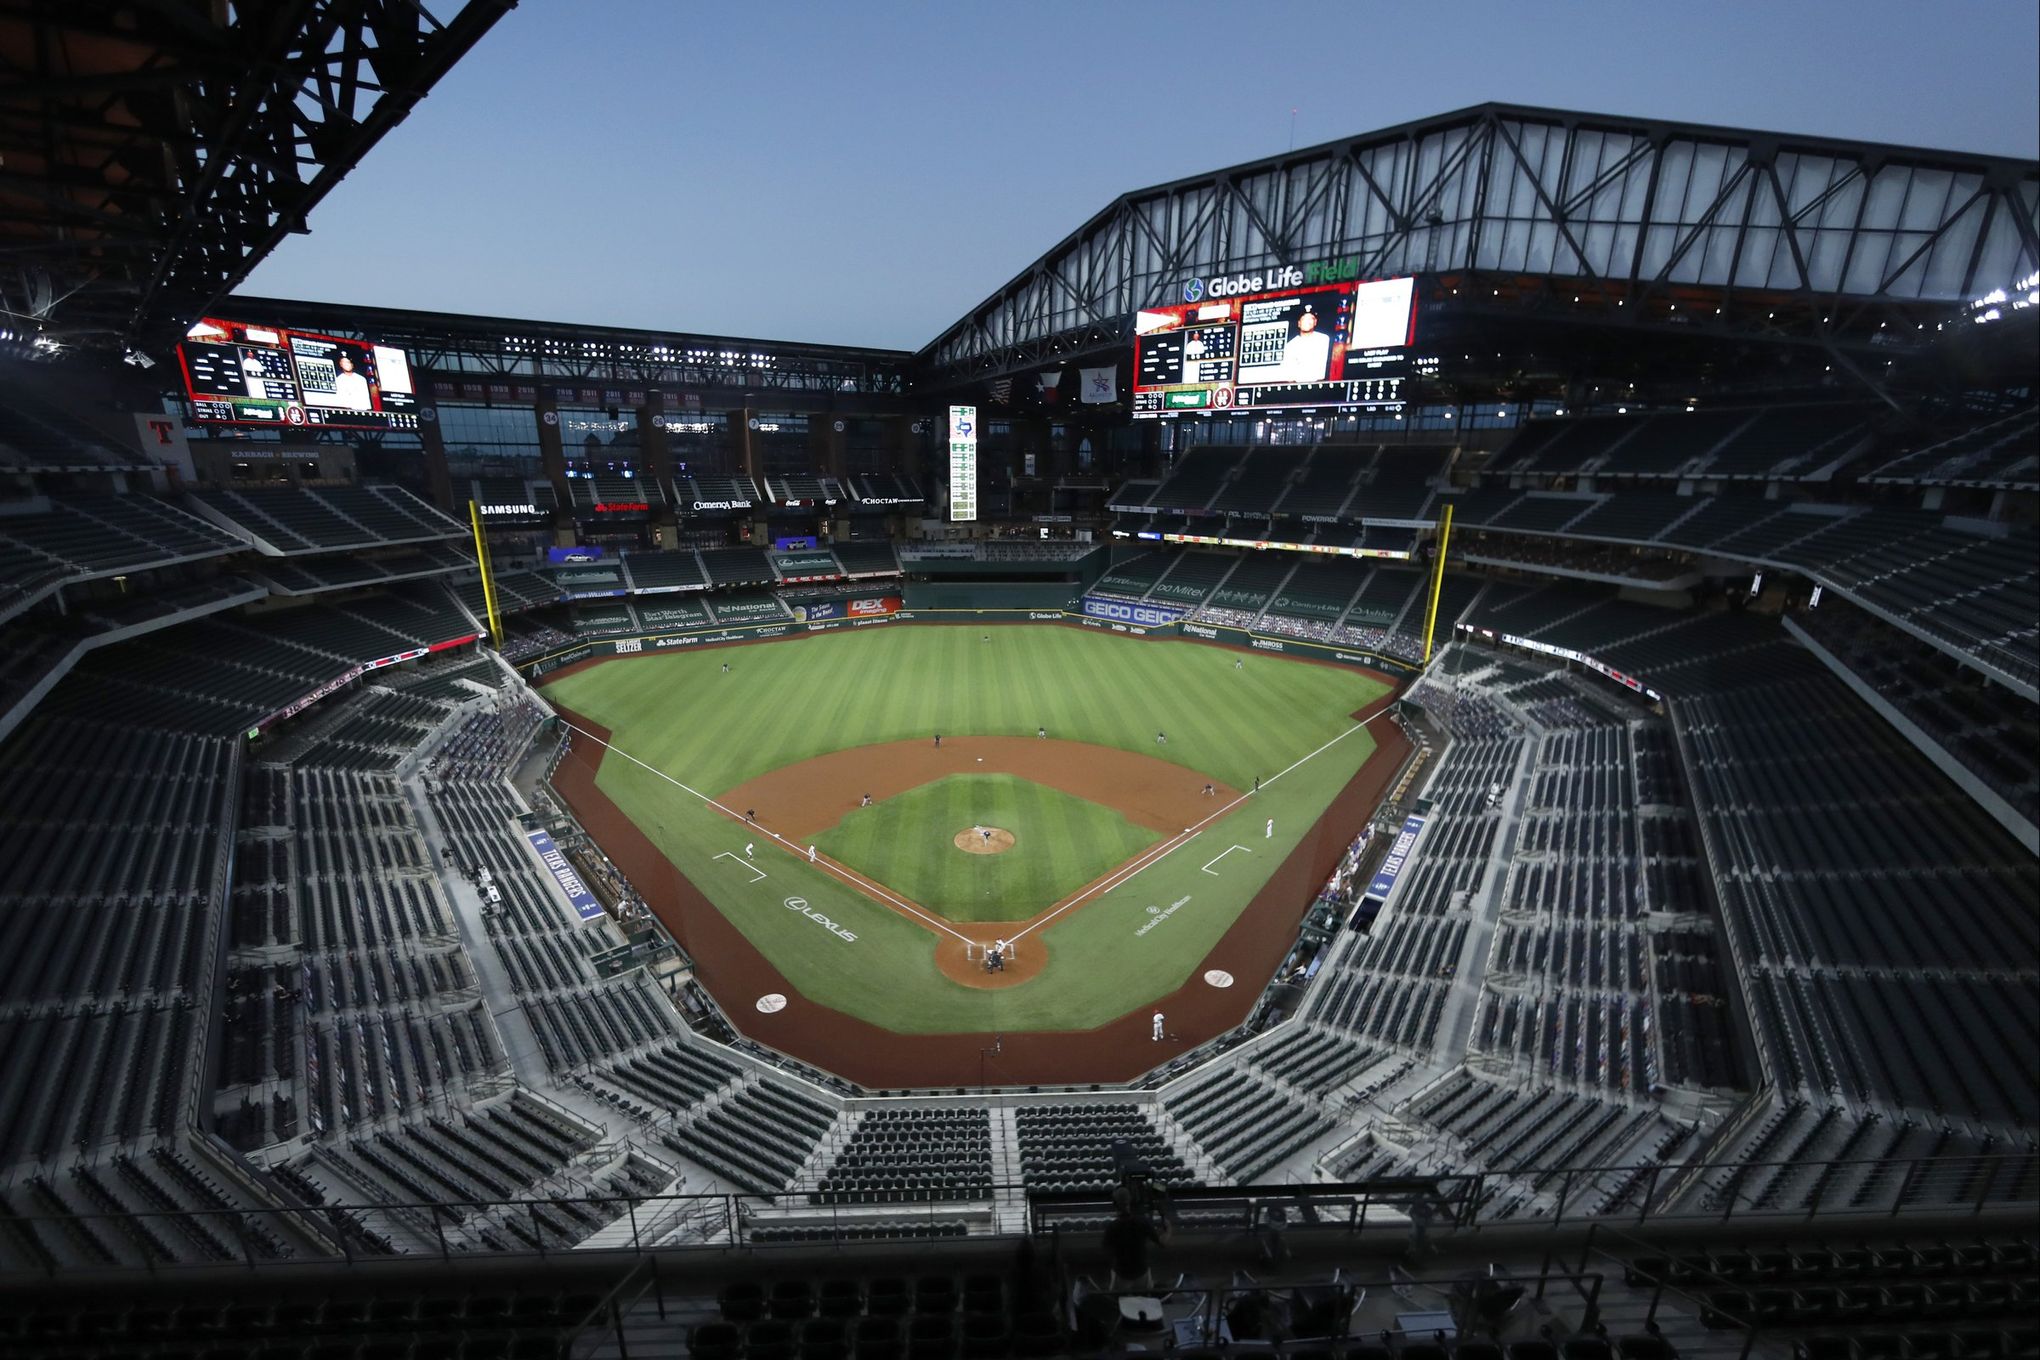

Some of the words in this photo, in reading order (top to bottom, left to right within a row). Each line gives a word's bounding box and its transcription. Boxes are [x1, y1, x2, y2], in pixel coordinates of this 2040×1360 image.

[1208, 274, 1262, 297] Globe
[1266, 265, 1303, 289] Life
[1307, 255, 1358, 284] Field
[545, 414, 556, 423] 34
[148, 420, 173, 445] T
[480, 504, 535, 515] SAMSUNG
[1172, 585, 1206, 597] Mitel
[731, 603, 775, 612] National
[851, 598, 884, 610] DEX
[1085, 601, 1131, 618] GEICO
[1191, 626, 1217, 636] National
[615, 642, 642, 654] SELTZER
[541, 848, 566, 870] TEXAS
[554, 867, 587, 898] RANGERS
[802, 907, 859, 942] LEXUS
